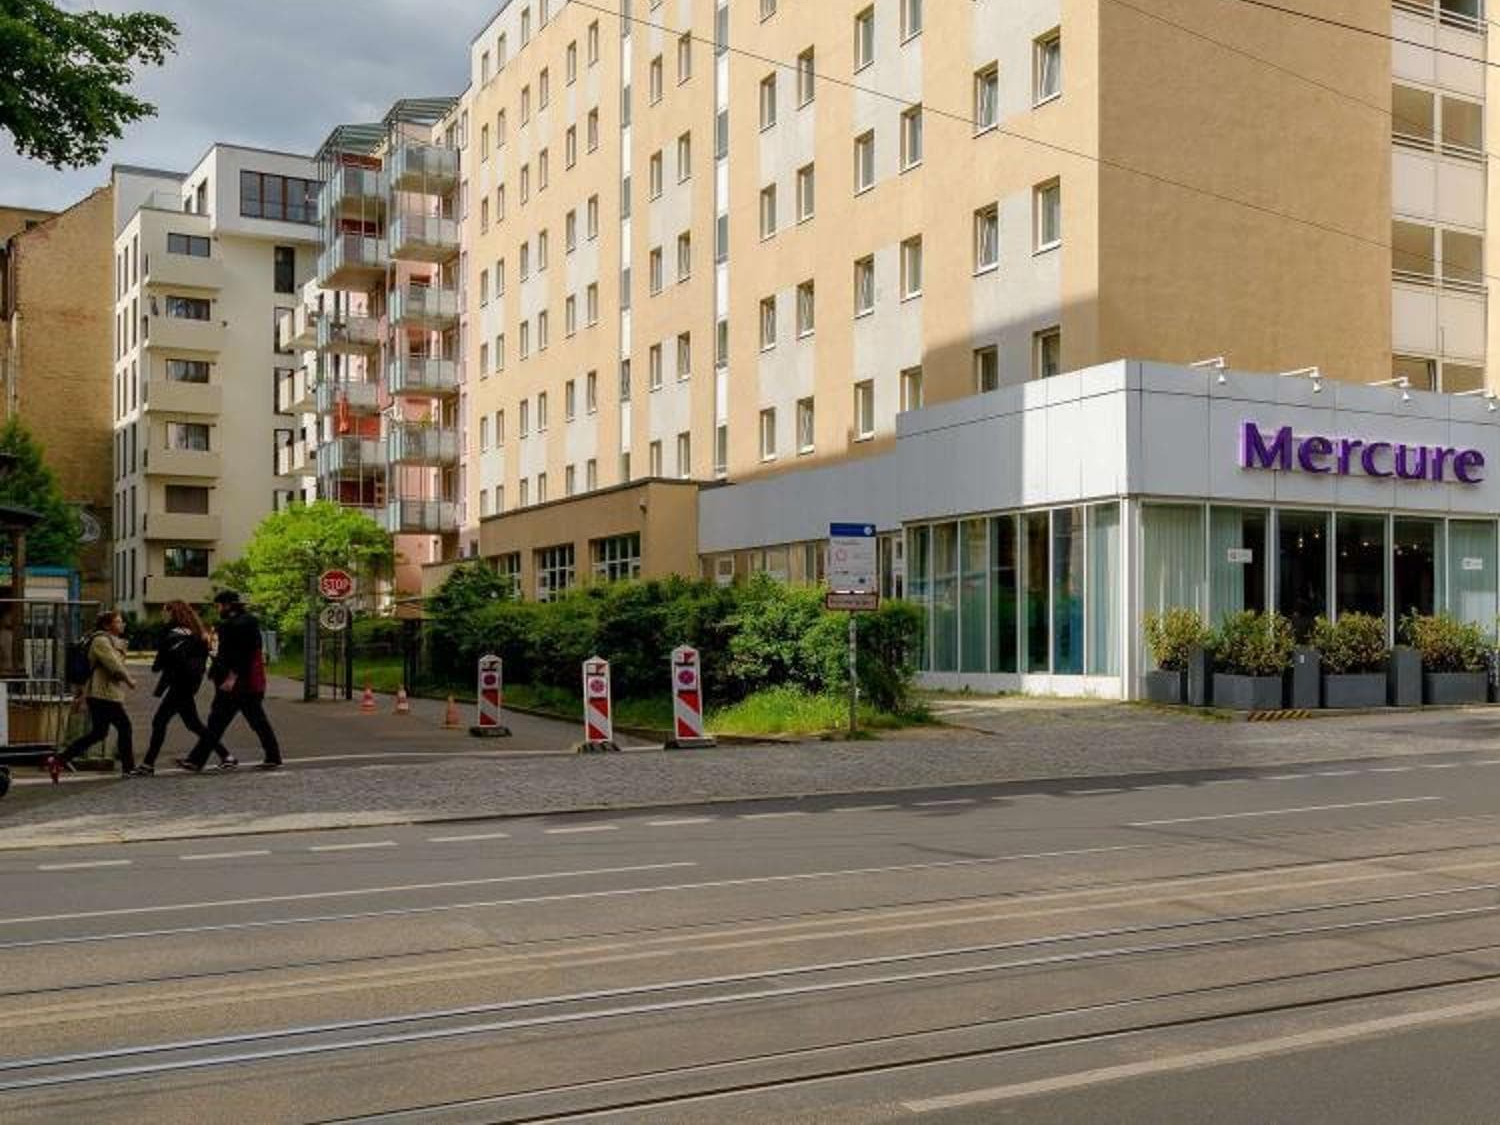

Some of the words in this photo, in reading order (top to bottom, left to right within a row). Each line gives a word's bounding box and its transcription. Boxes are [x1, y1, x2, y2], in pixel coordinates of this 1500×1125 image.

[1240, 420, 1485, 484] Mercure
[323, 579, 349, 590] STOP
[328, 609, 345, 624] 20
